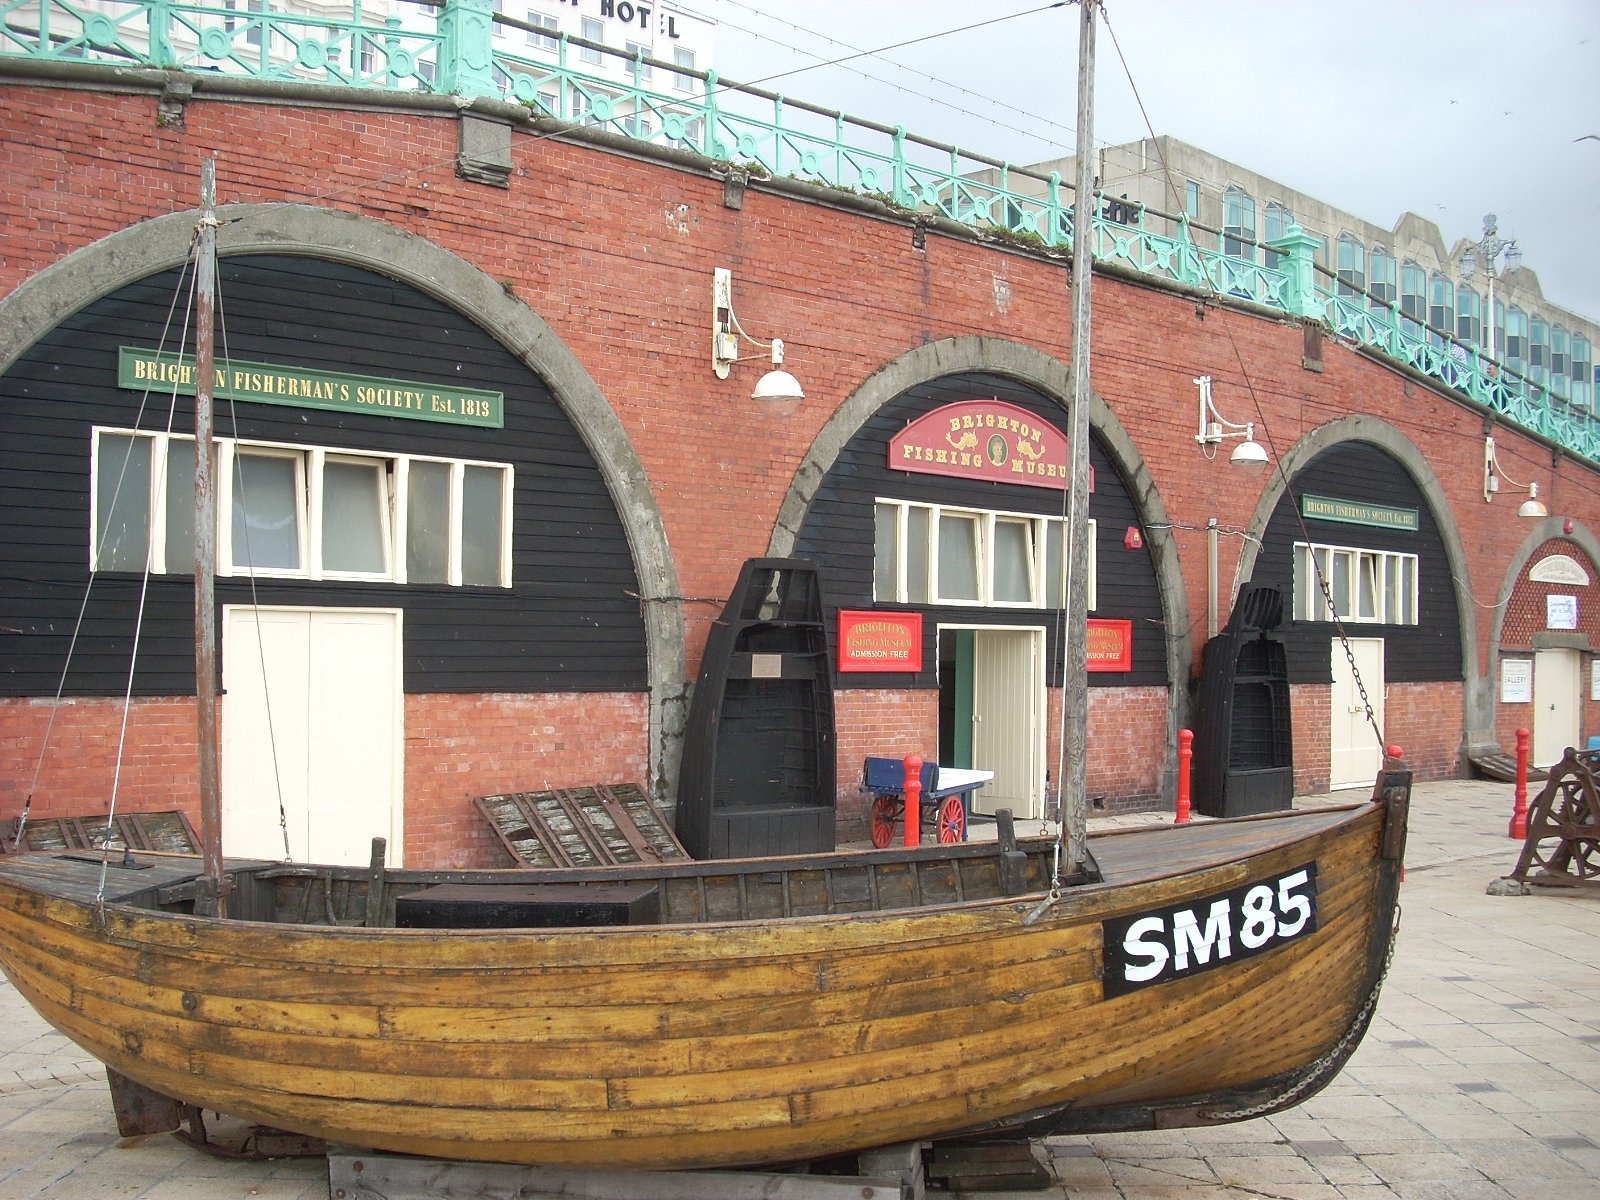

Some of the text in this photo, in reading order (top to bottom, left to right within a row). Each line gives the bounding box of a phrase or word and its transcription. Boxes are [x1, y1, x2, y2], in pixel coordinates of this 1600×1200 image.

[134, 359, 490, 417] BRIGHN FISHERMAN'S SOCIETY Est. 1813
[949, 414, 1042, 443] BRIGHTON
[903, 444, 1067, 478] FISHING MUSEU
[855, 622, 905, 635] BRIGHTON
[850, 650, 908, 658] ADMISSION FREE
[1106, 652, 1120, 660] FREE
